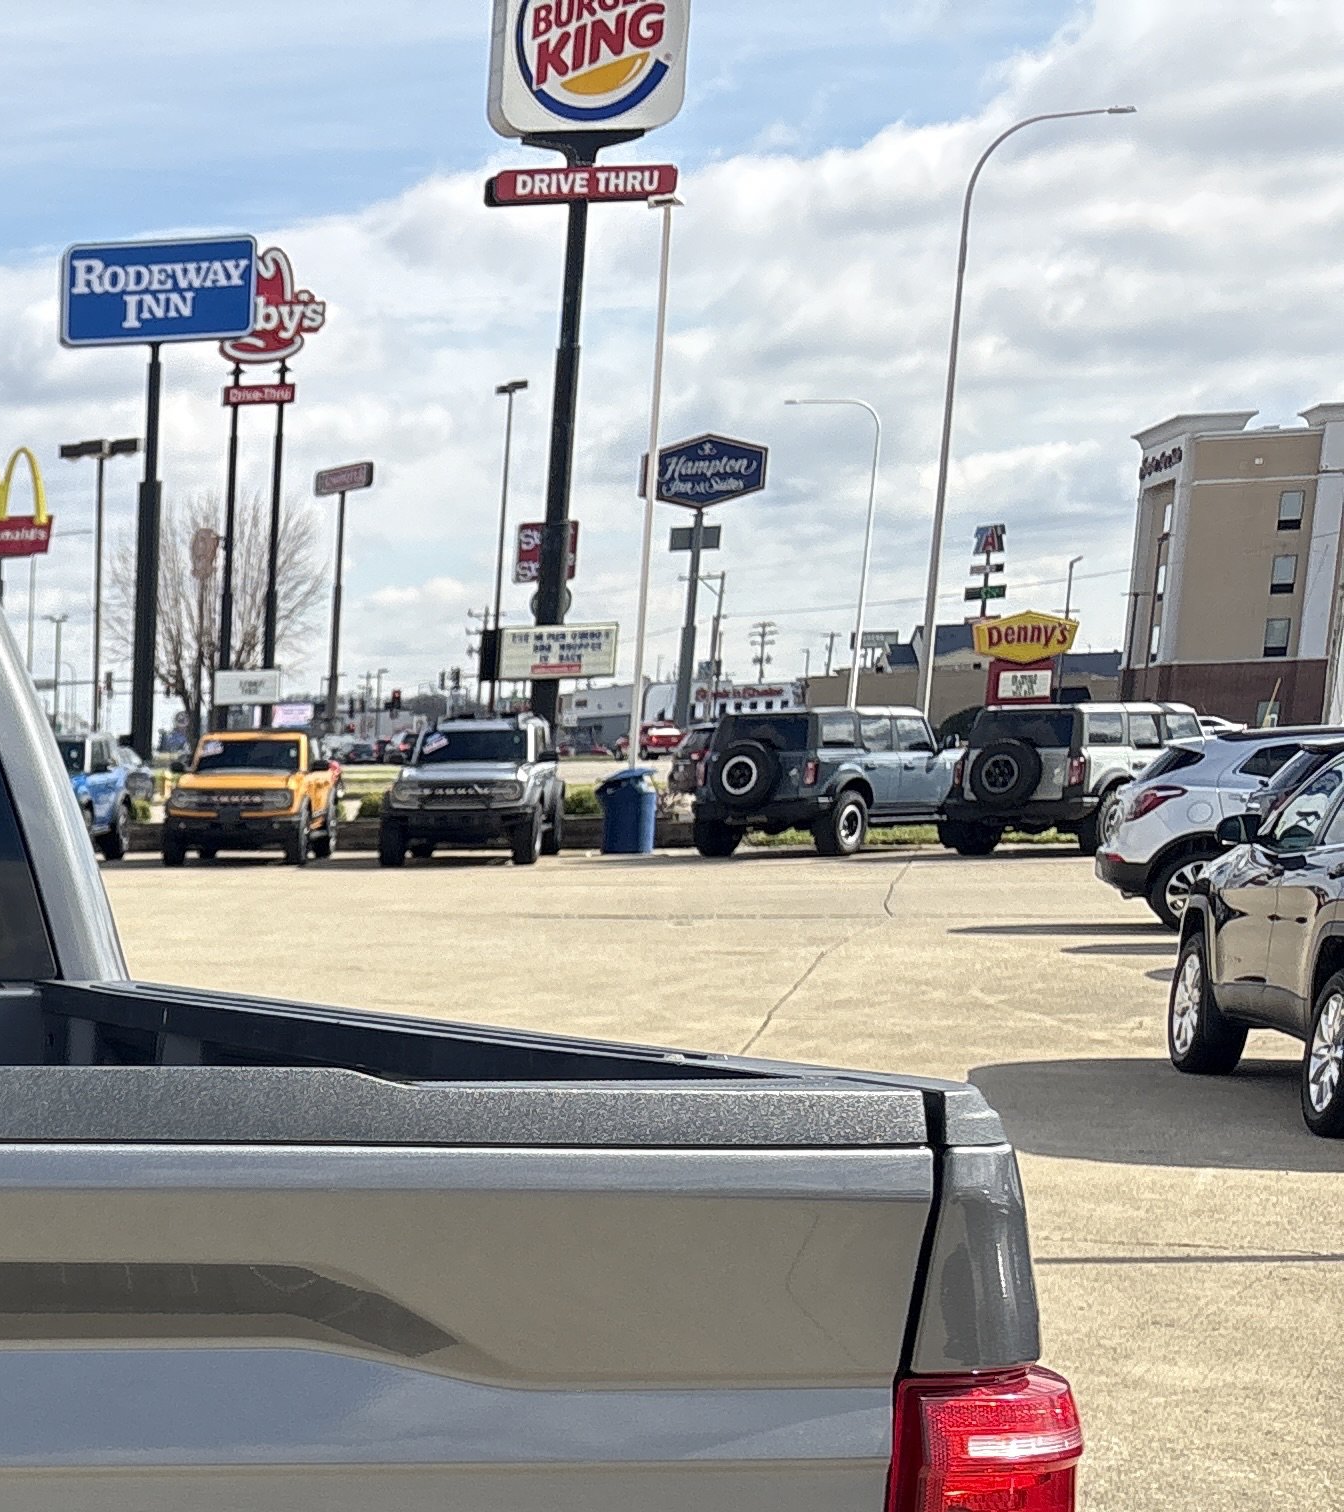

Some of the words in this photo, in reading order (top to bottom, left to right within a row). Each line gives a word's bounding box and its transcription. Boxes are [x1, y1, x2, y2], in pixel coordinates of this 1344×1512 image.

[535, 3, 666, 86] KING
[515, 172, 590, 196] DRIVE
[596, 170, 660, 193] THRU
[71, 257, 250, 295] RODEWAY
[122, 291, 195, 329] INN
[661, 455, 757, 482] Hampton
[662, 479, 694, 496] Inn
[708, 475, 745, 494] Suites
[987, 621, 1070, 650] Denny's
